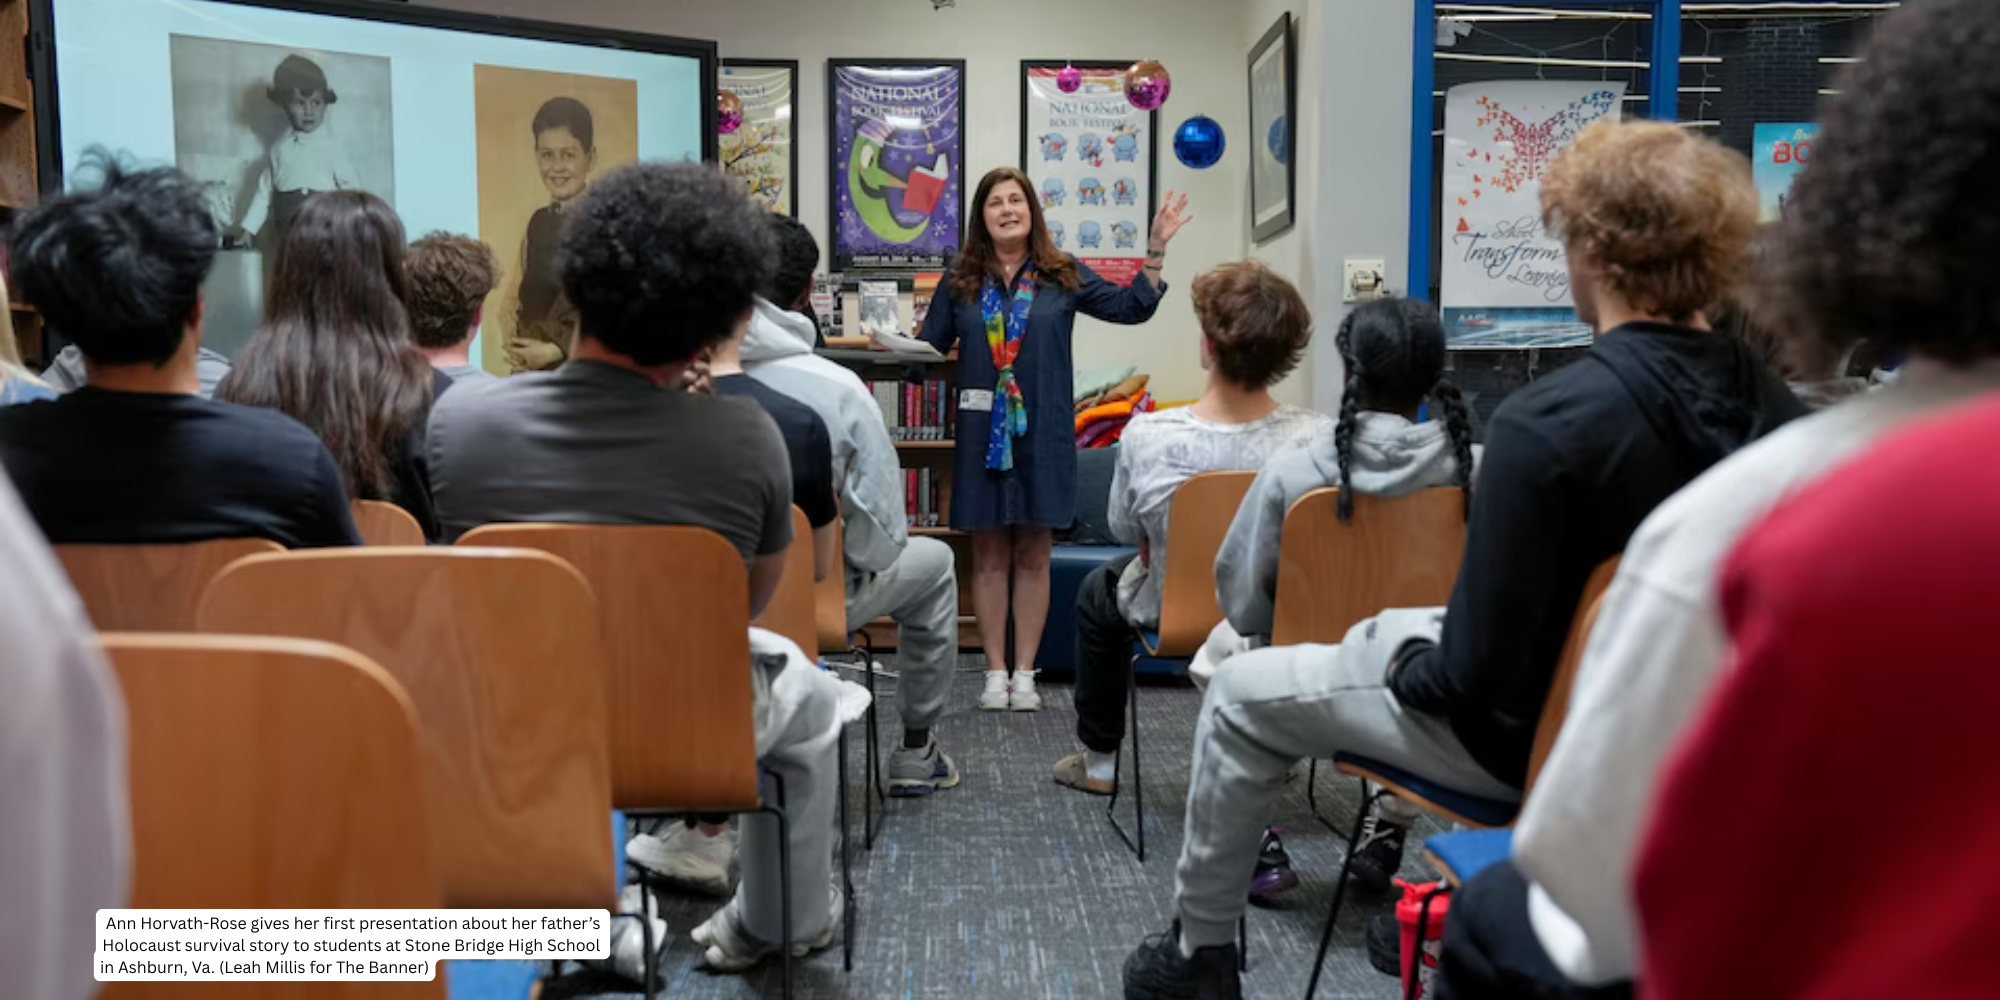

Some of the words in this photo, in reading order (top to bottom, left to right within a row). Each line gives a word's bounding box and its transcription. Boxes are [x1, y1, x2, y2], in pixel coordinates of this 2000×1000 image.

[851, 87, 939, 100] NATIONAL
[1049, 102, 1128, 114] NATIONAL
[1049, 118, 1079, 127] BOOK
[1452, 232, 1565, 279] Transform
